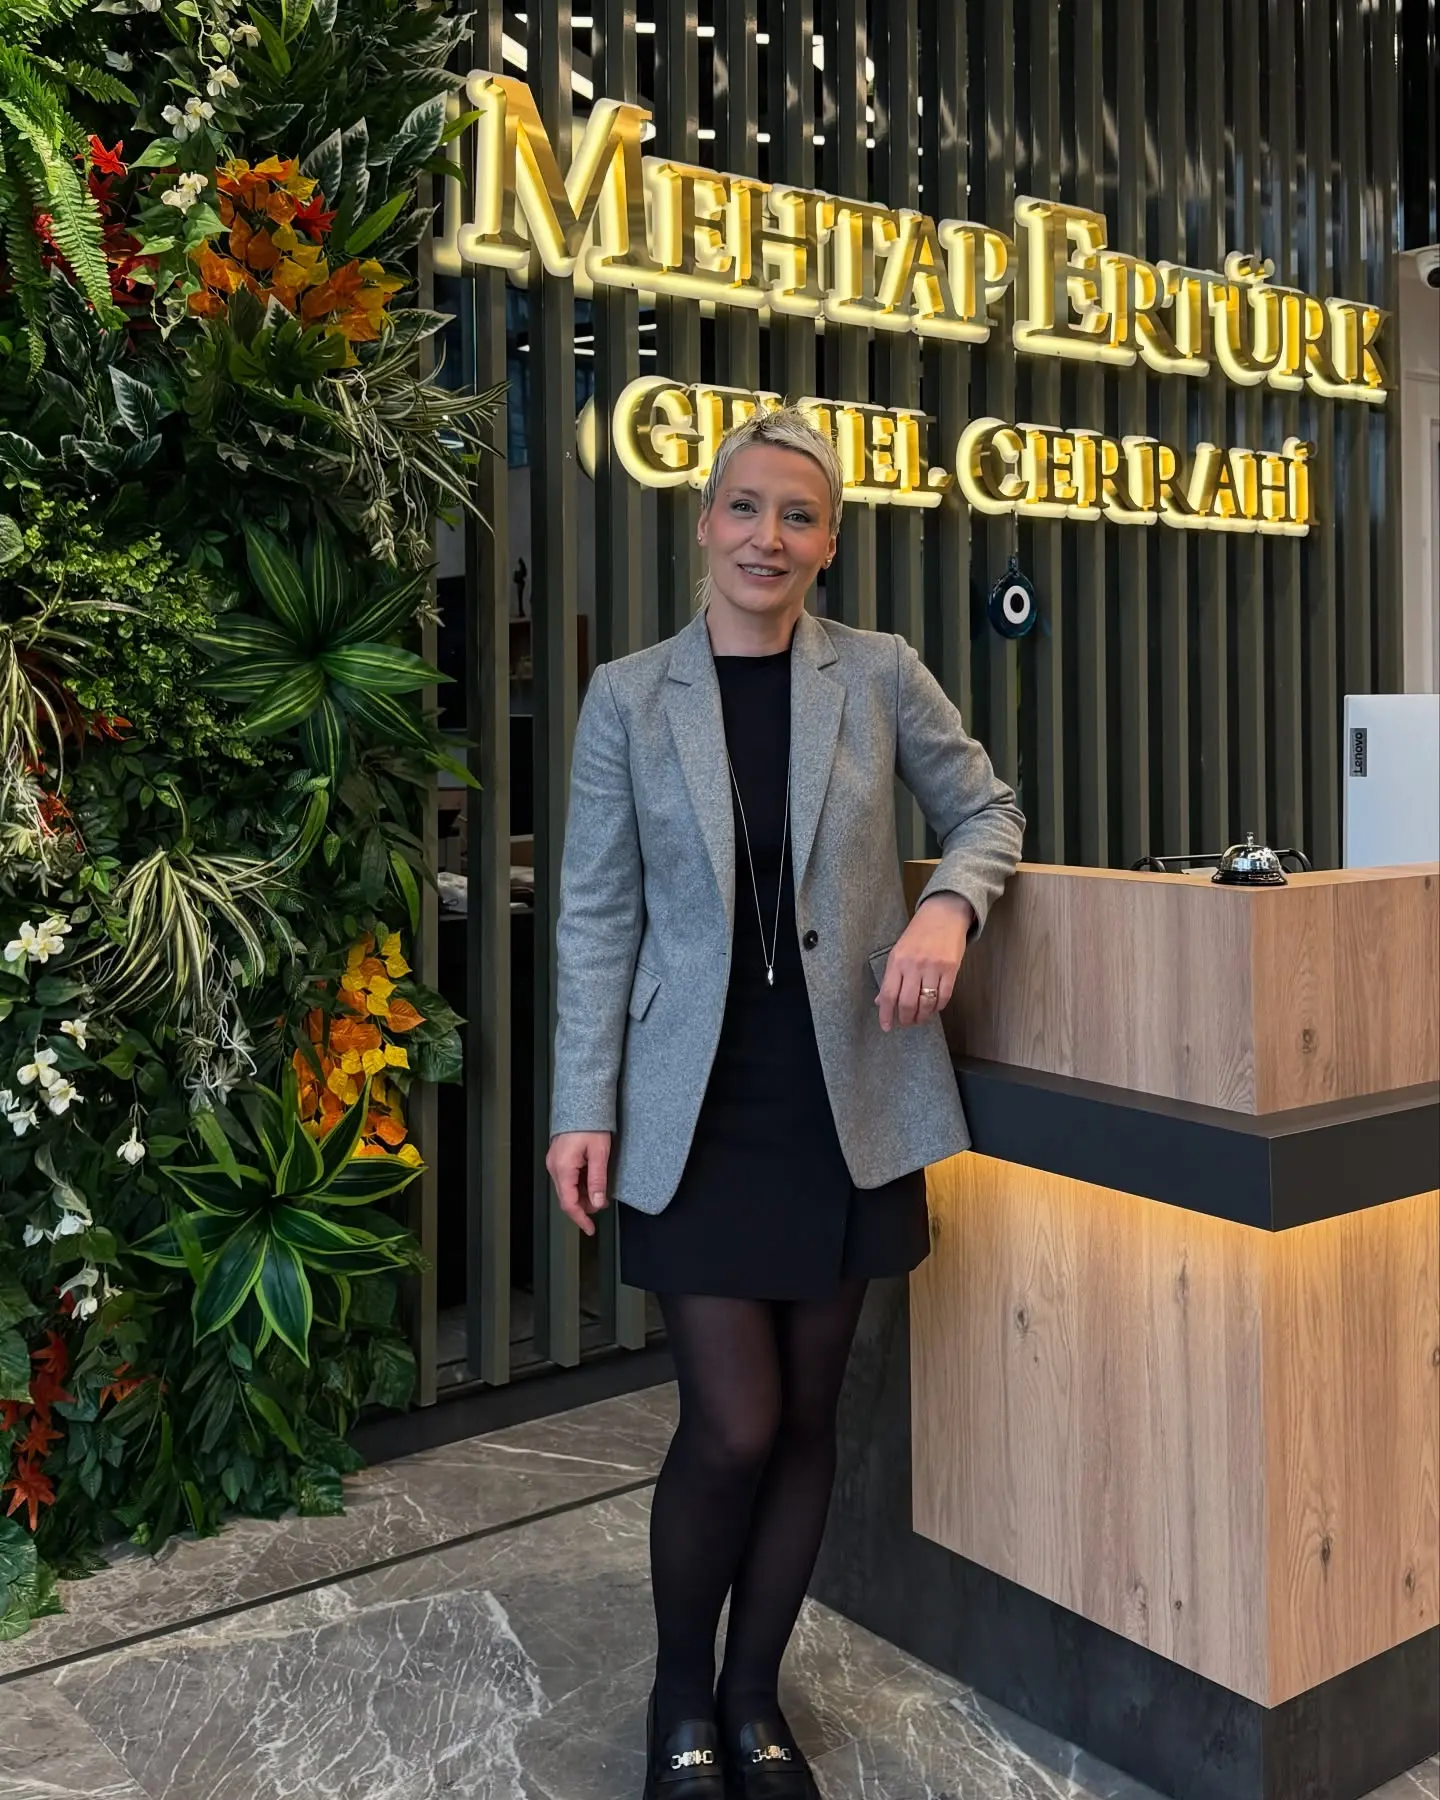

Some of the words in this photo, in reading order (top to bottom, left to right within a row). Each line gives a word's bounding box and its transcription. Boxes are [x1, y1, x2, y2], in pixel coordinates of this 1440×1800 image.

[460, 70, 1018, 343] MEHTAP
[1014, 196, 1394, 403] ERTÜRK
[613, 376, 952, 508] GEL
[957, 417, 1319, 537] CERRAHİ
[1353, 731, 1364, 774] Lenovo
